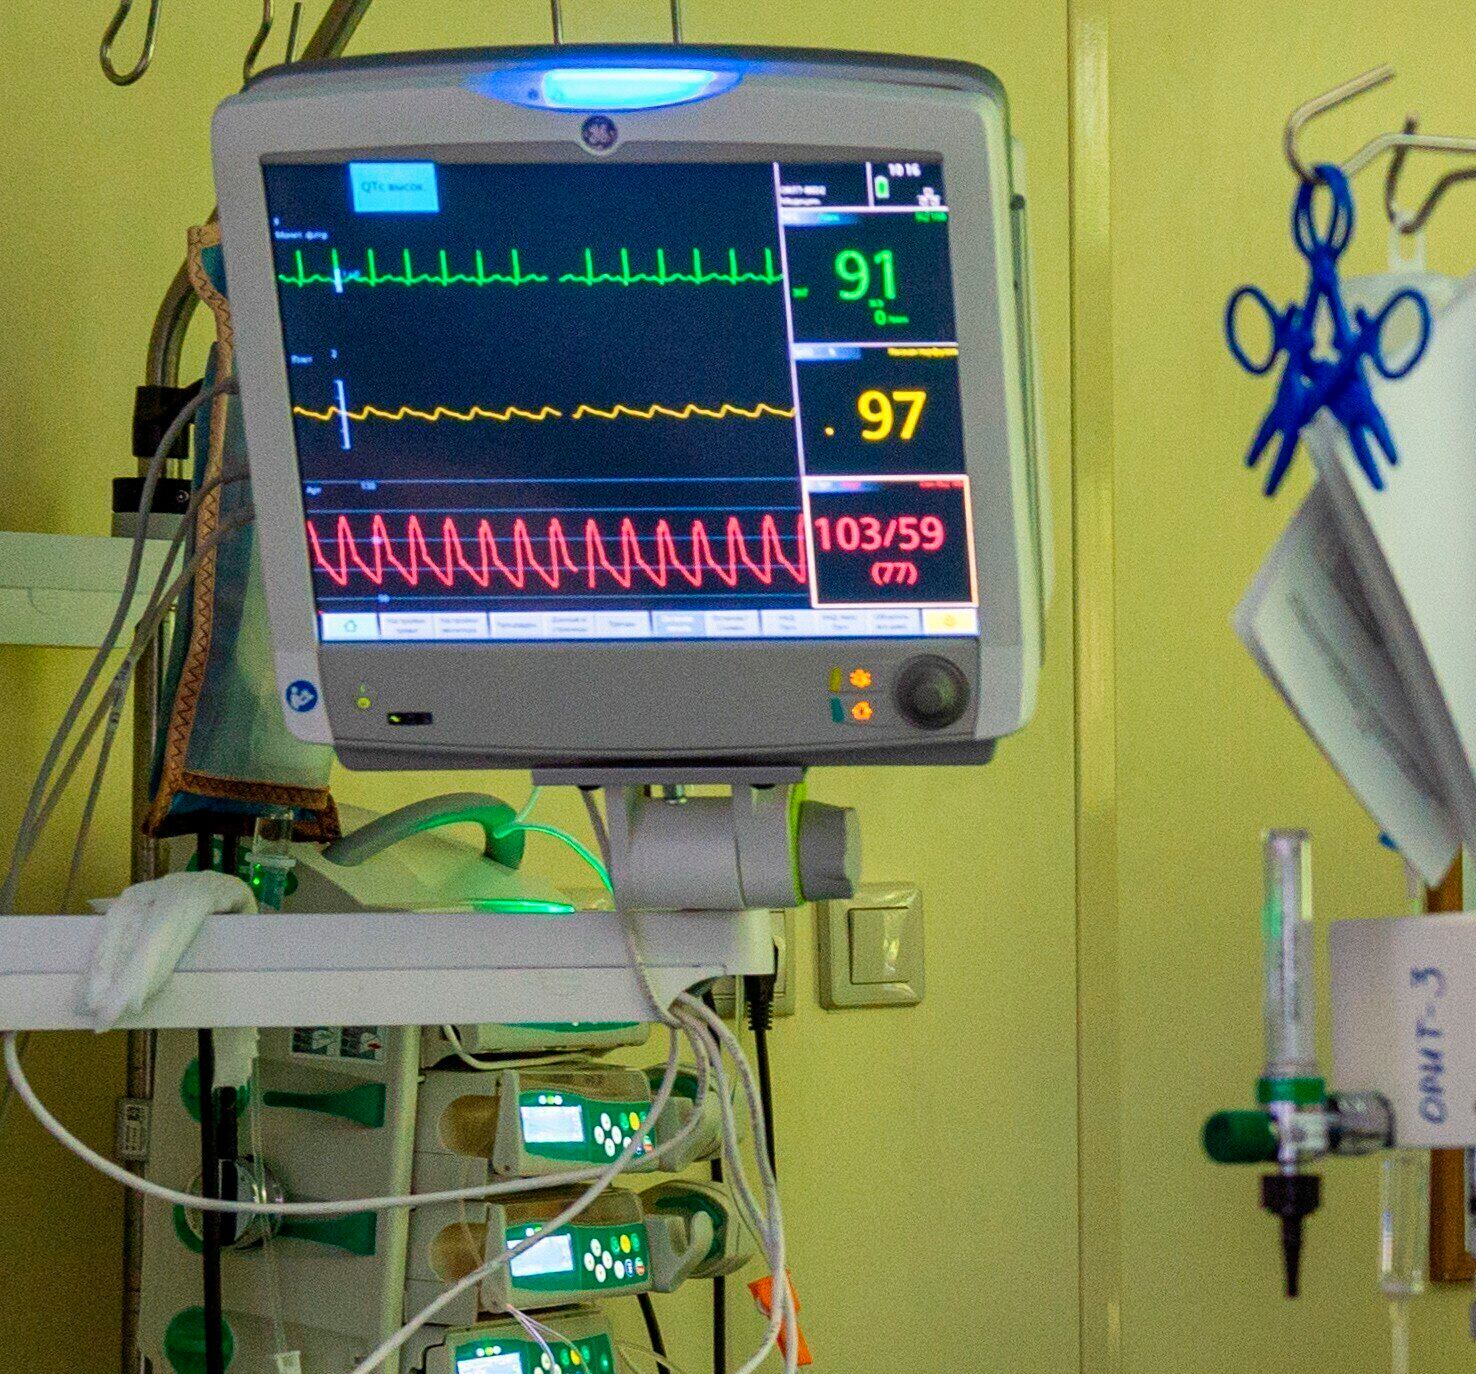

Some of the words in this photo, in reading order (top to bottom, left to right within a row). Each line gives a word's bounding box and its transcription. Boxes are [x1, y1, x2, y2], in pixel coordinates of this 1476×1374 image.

[835, 250, 896, 300] 91
[857, 389, 927, 441] 97
[814, 516, 945, 551] 103/59
[870, 561, 919, 585] (77)
[1410, 965, 1447, 1125] ОРИТ-3
